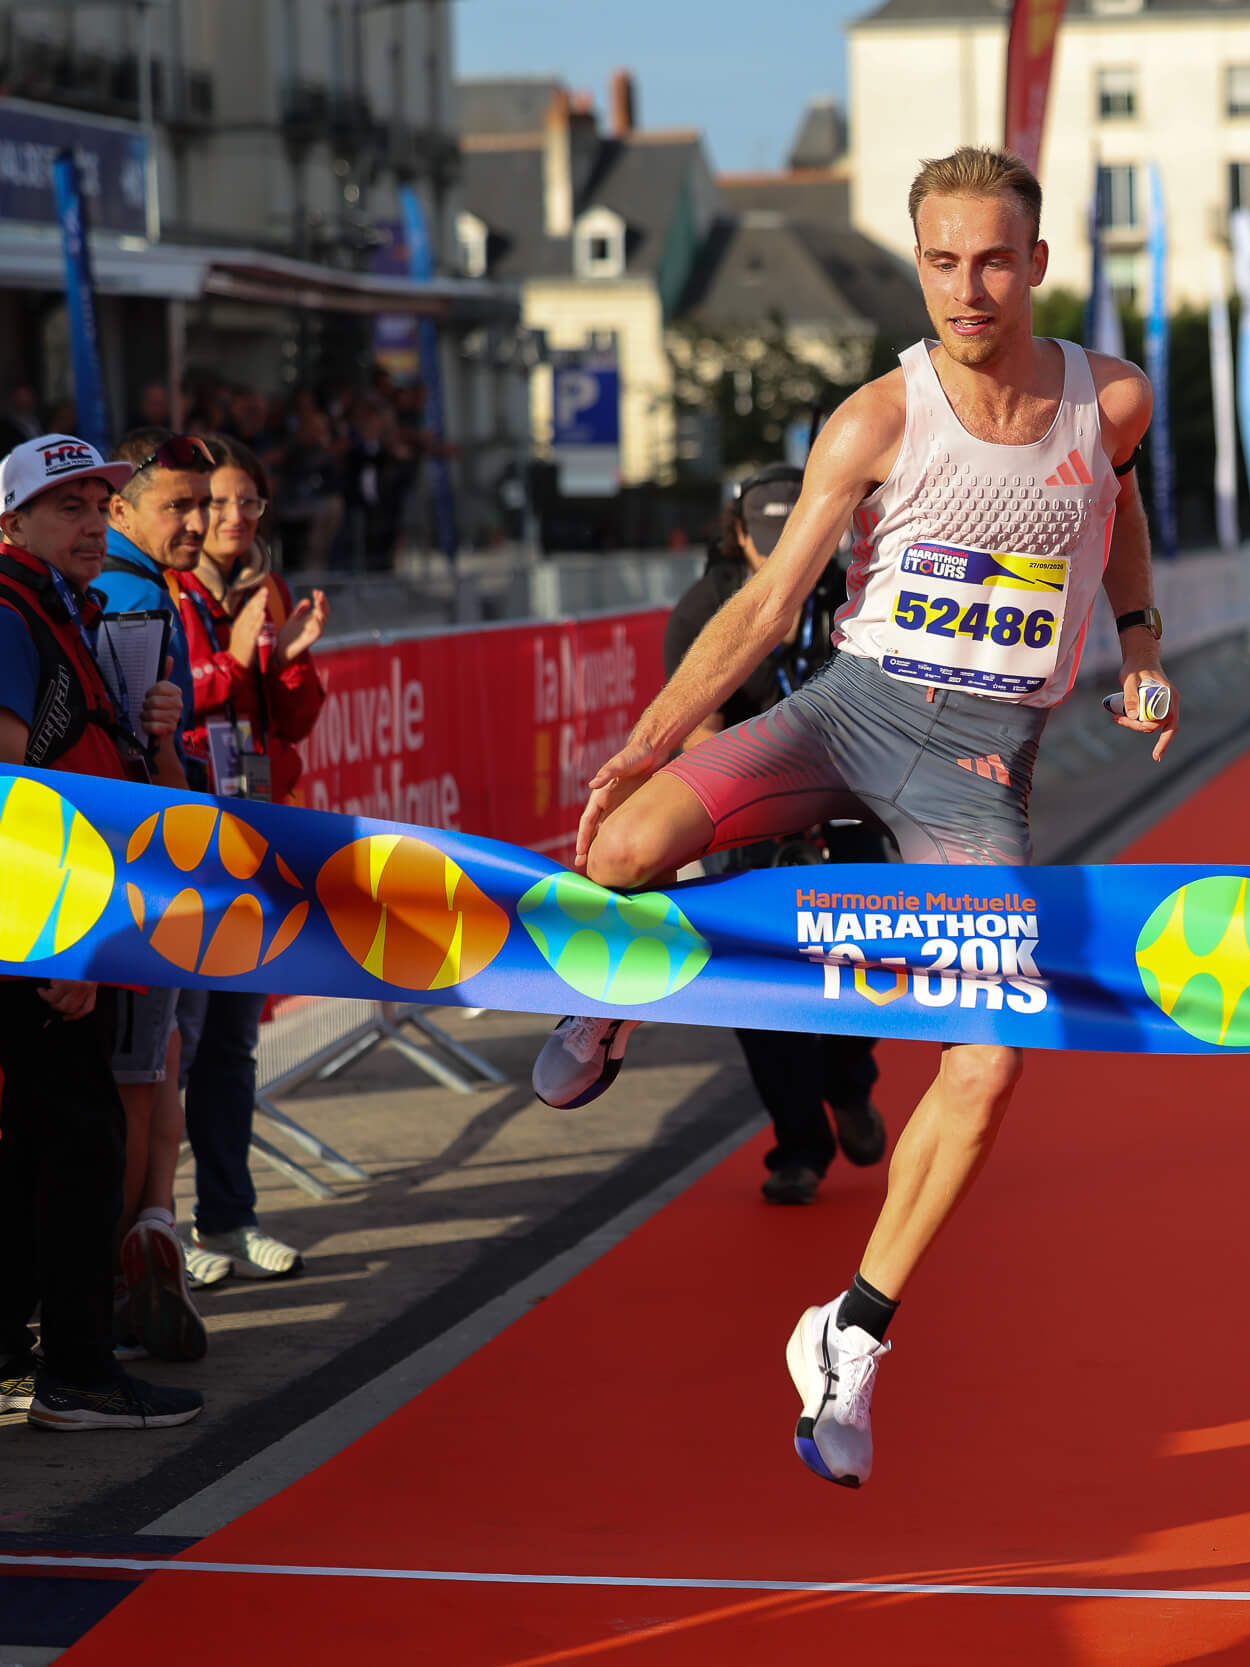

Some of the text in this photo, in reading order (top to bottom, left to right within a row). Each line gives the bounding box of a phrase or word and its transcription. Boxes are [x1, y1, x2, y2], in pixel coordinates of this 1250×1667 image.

[44, 445, 92, 467] HRC
[907, 548, 968, 567] MARATHON
[912, 557, 966, 580] TOURS
[894, 590, 1055, 649] 52486
[796, 889, 1037, 912] Harmonie Mutuelle
[797, 911, 1039, 943] MARATHON
[920, 938, 1041, 978] 20K
[809, 956, 1049, 1014] TOURS
